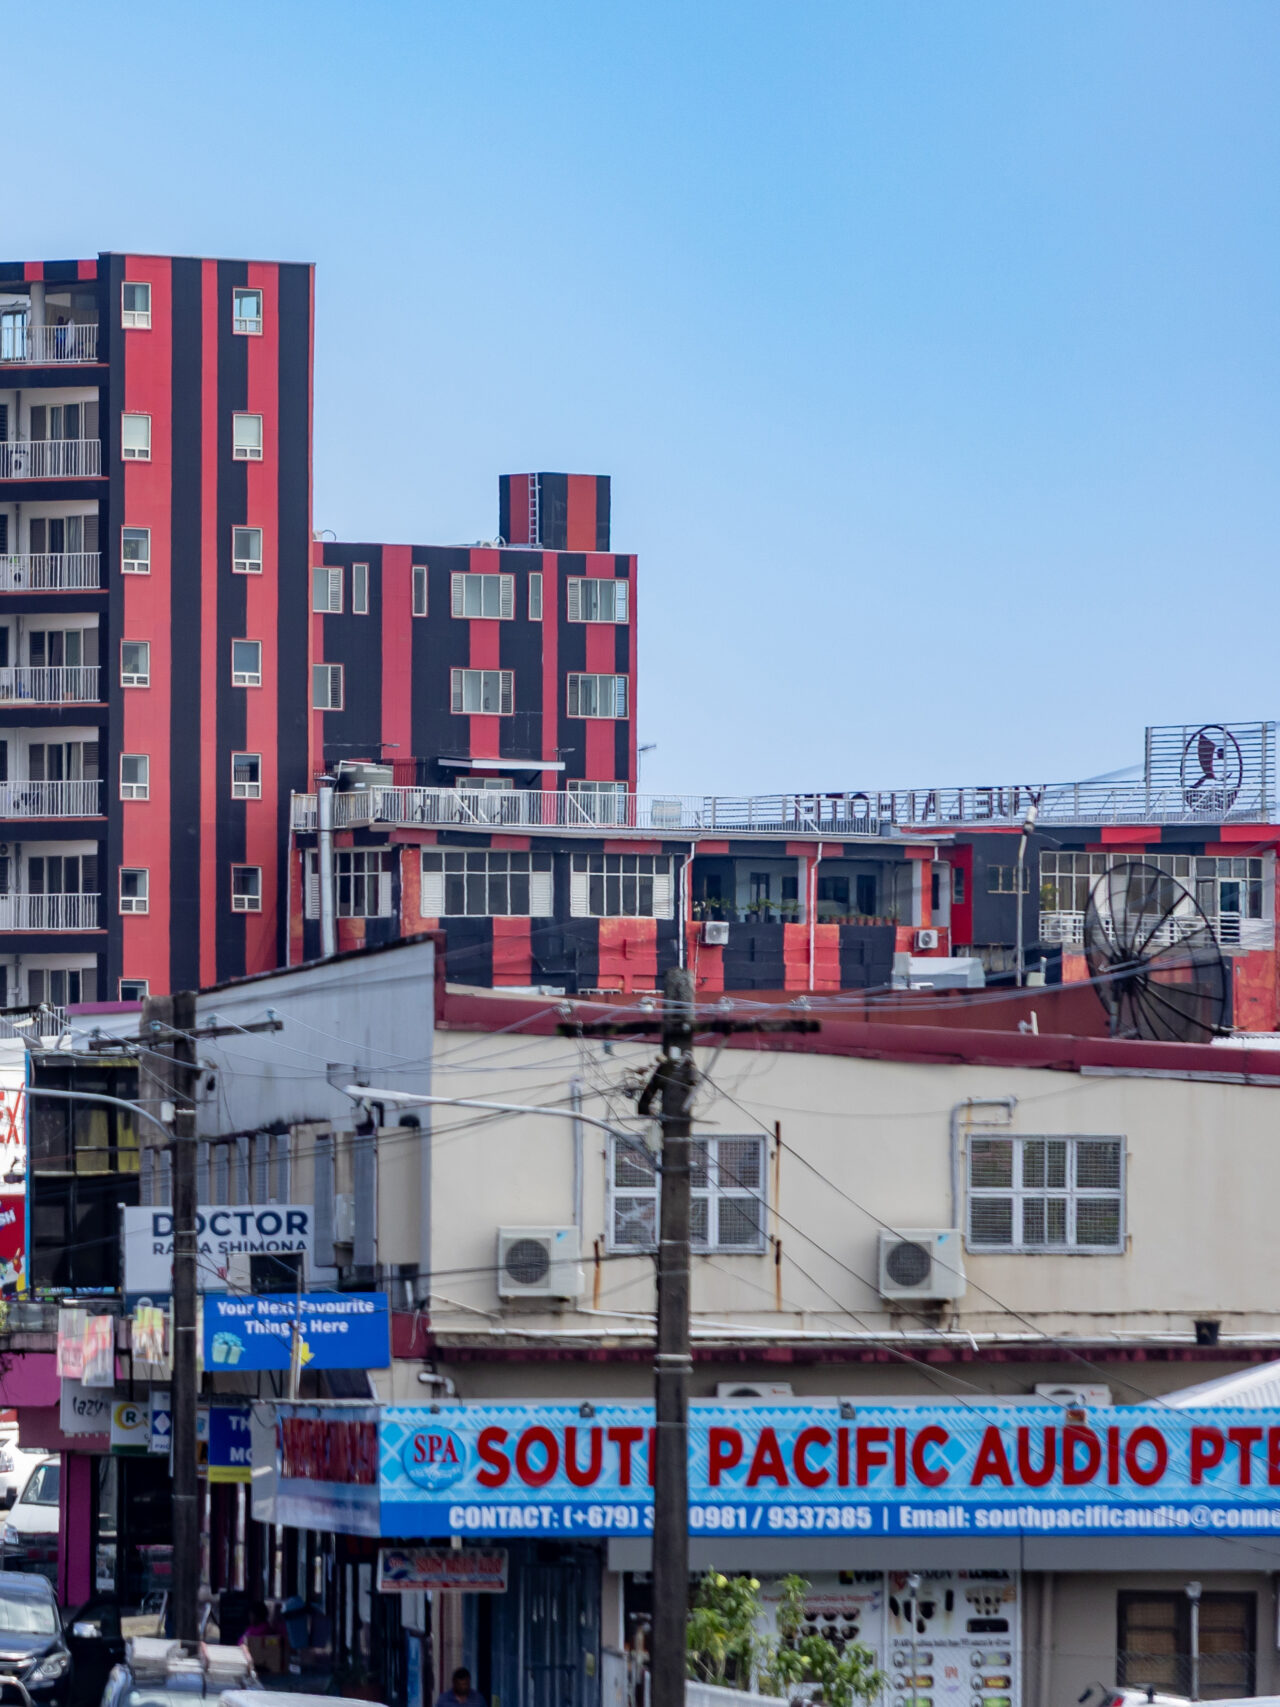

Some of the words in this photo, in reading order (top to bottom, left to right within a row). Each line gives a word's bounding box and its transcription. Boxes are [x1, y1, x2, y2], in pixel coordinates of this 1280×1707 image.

[218, 1240, 307, 1254] SHIMONA
[217, 1301, 254, 1316] Your
[258, 1301, 295, 1315] Next
[299, 1300, 375, 1314] Favourite
[244, 1320, 293, 1338] Thing
[310, 1319, 349, 1333] Here
[413, 1433, 460, 1464] SPA
[476, 1426, 656, 1488] SOUT
[709, 1426, 950, 1488] PACIFIC
[970, 1425, 1168, 1487] AUDIO
[449, 1505, 559, 1530] CONTACT:
[563, 1505, 638, 1530] (+679)
[644, 1505, 747, 1530] 30981
[767, 1505, 872, 1530] 9337385
[900, 1505, 970, 1529] Email:
